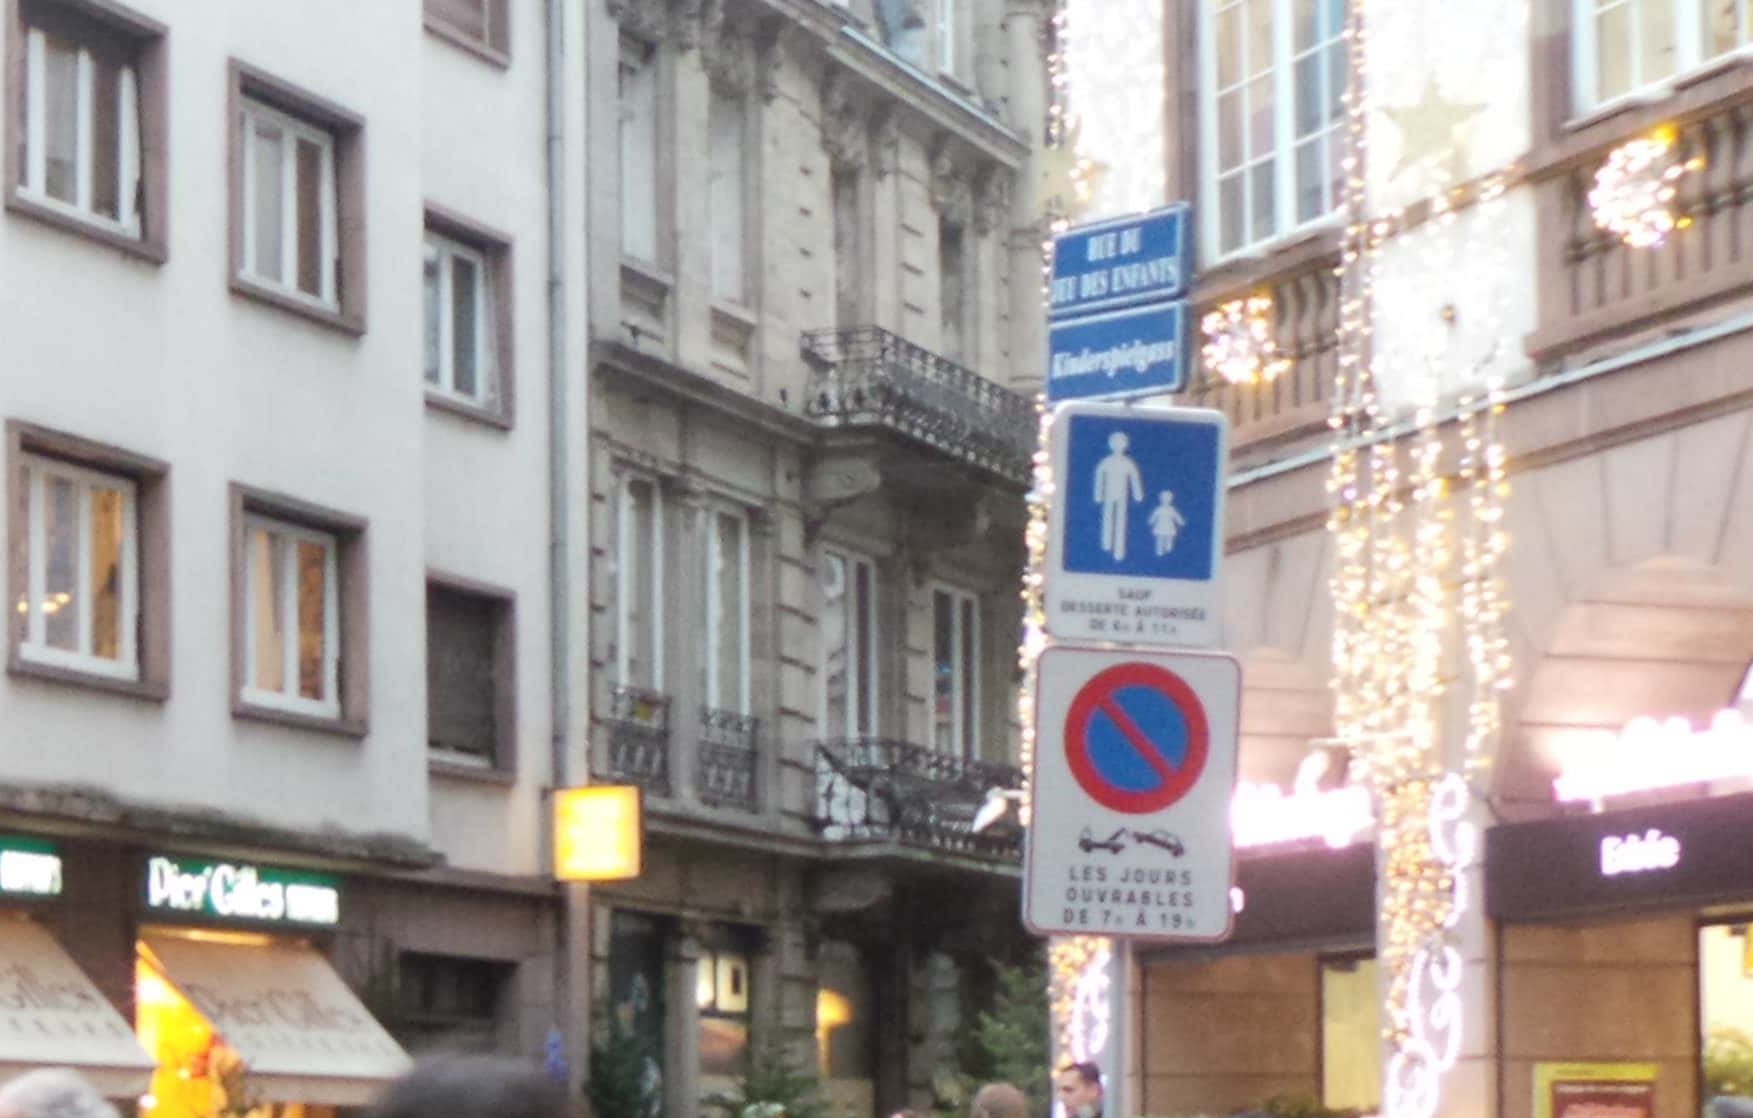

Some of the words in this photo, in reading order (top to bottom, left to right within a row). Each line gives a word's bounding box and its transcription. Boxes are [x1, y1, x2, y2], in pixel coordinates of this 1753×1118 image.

[1087, 232, 1118, 262] RUE
[1120, 227, 1142, 255] DU
[1111, 255, 1179, 293] ENFANTS
[1118, 587, 1152, 600] SAUF
[1060, 600, 1128, 616] DESSERTE
[1069, 865, 1108, 882] LES
[1119, 867, 1192, 885] JOURS
[1065, 886, 1193, 907] OUVRABLES
[1063, 907, 1089, 924] DE
